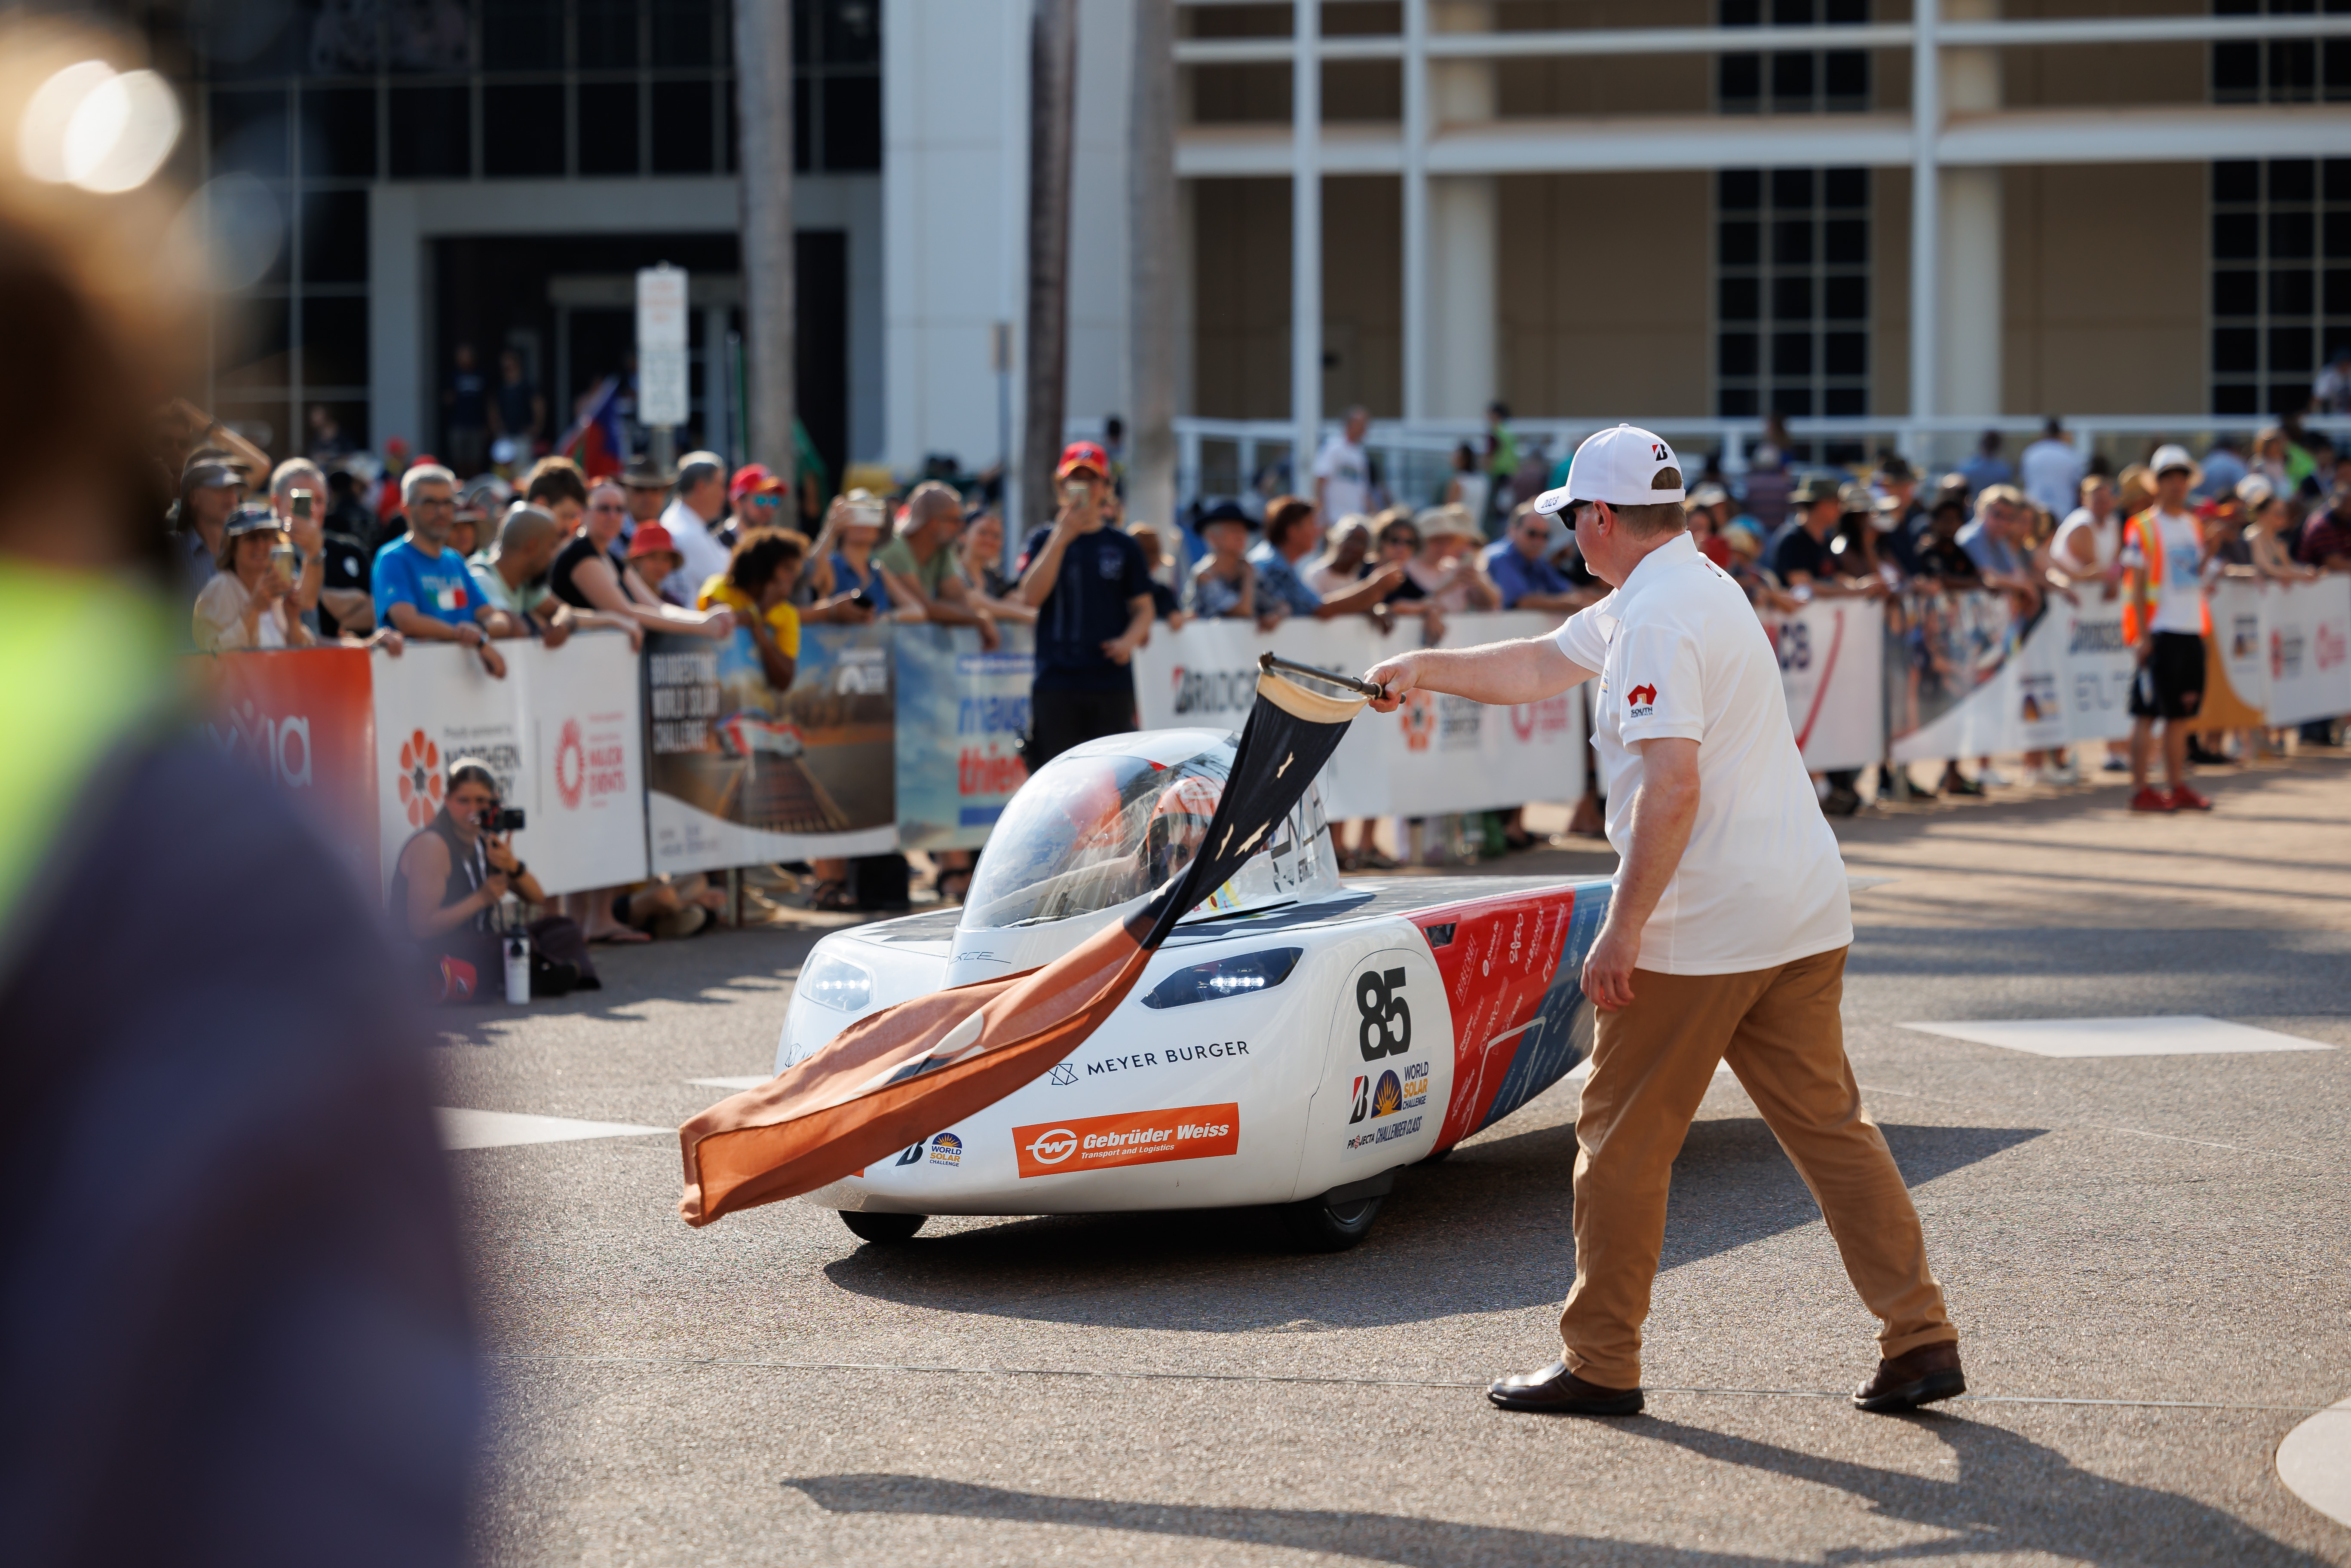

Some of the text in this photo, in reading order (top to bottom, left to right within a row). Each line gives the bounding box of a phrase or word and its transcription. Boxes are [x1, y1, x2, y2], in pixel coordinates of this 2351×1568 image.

[1541, 496, 1559, 508] 2023
[1631, 707, 1652, 716] SOUTH
[1456, 933, 1477, 1002] TRIBECRAFT
[1356, 967, 1411, 1062] 85
[1087, 1041, 1250, 1075] MEYER BURGER
[1404, 1061, 1429, 1081] WORLD
[1404, 1078, 1428, 1098] SOLAR
[1403, 1095, 1427, 1110] CHALLENGE
[1083, 1123, 1230, 1150] Gebrüder Weiss
[1347, 1115, 1422, 1150] PROJECTA CHALLENGER CLASS
[930, 1152, 961, 1162] SOLAR
[932, 1146, 962, 1155] WORLD
[1081, 1143, 1175, 1159] Transport and Logistics
